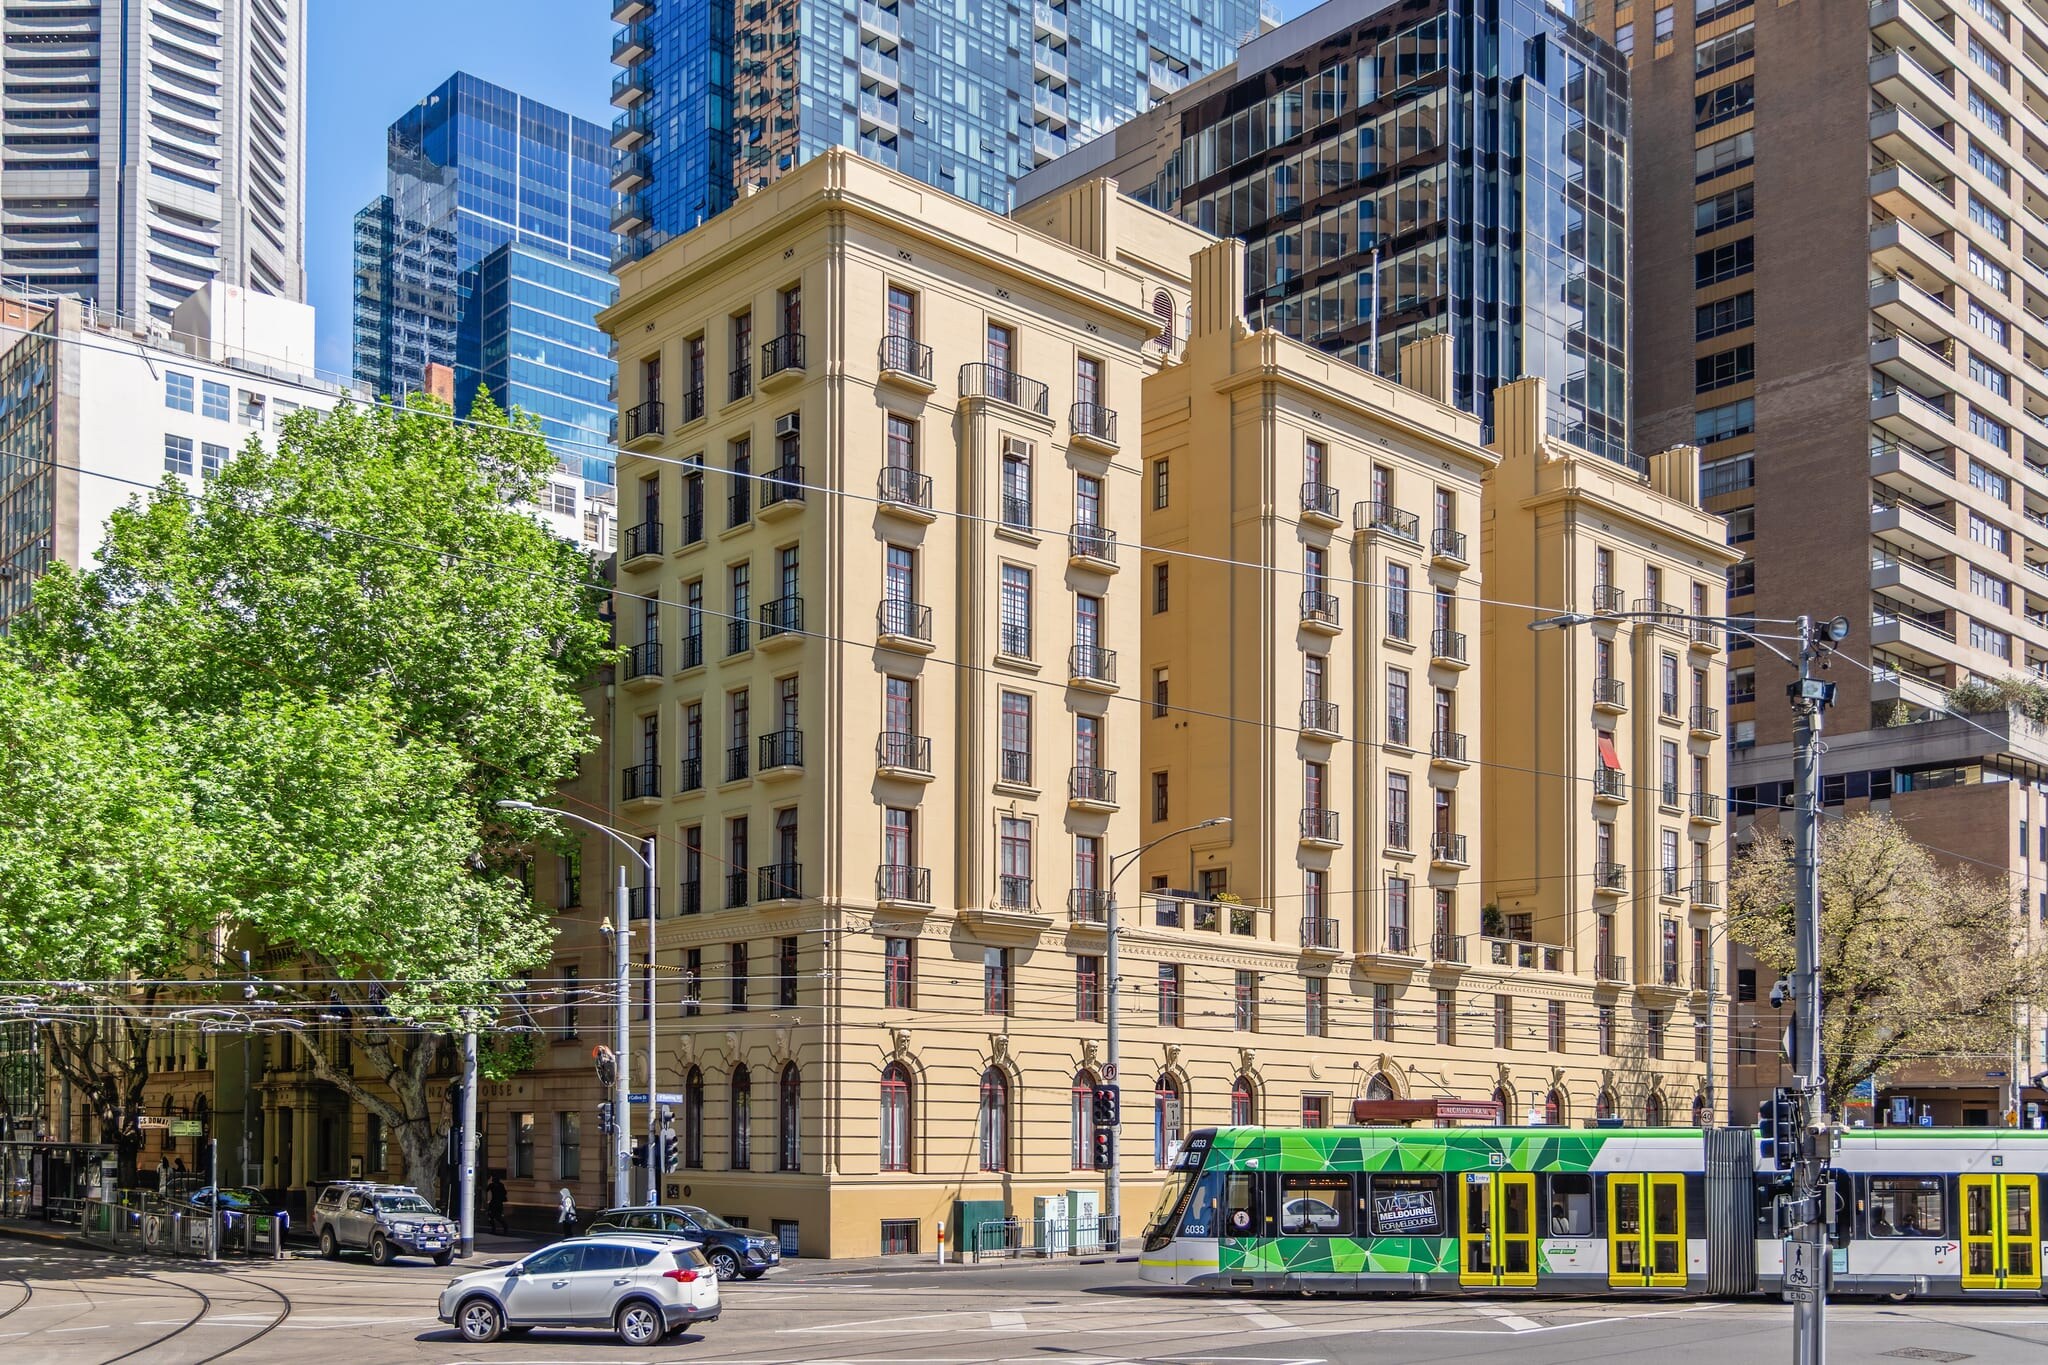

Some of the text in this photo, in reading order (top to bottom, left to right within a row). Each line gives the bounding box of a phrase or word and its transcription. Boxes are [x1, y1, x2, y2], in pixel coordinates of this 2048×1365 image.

[476, 1084, 512, 1097] OUSE
[148, 1117, 170, 1127] DOMAI
[1922, 1118, 1929, 1126] P
[1191, 1139, 1206, 1148] 6033
[1377, 1192, 1433, 1213] MADE IN
[1379, 1206, 1434, 1221] MELBOURNE
[1380, 1216, 1435, 1231] FOR MELBOURNE
[1184, 1224, 1206, 1235] 6033
[1790, 1292, 1807, 1300] END
